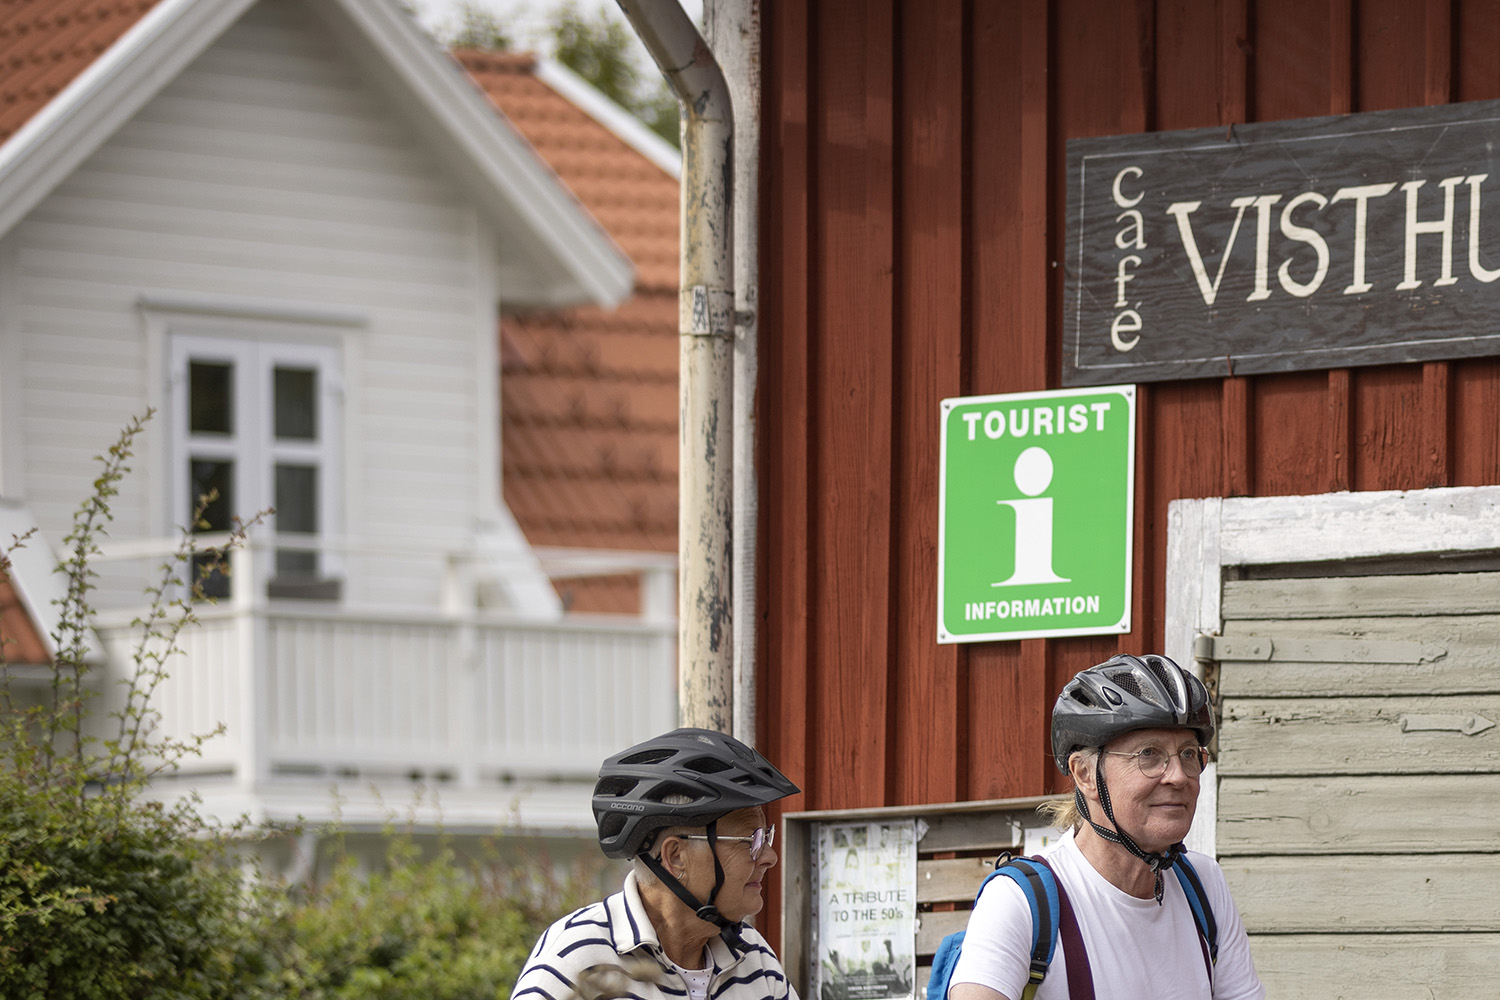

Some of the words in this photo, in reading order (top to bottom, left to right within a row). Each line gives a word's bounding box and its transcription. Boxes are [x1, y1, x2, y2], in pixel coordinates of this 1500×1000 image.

[1110, 165, 1144, 352] café
[962, 402, 1111, 441] TOURIST
[965, 595, 1100, 621] INFORMATION
[828, 894, 839, 905] A
[843, 890, 907, 904] TRIBUTE
[833, 911, 849, 922] TO
[852, 909, 877, 921] THE
[881, 907, 904, 920] 50's
